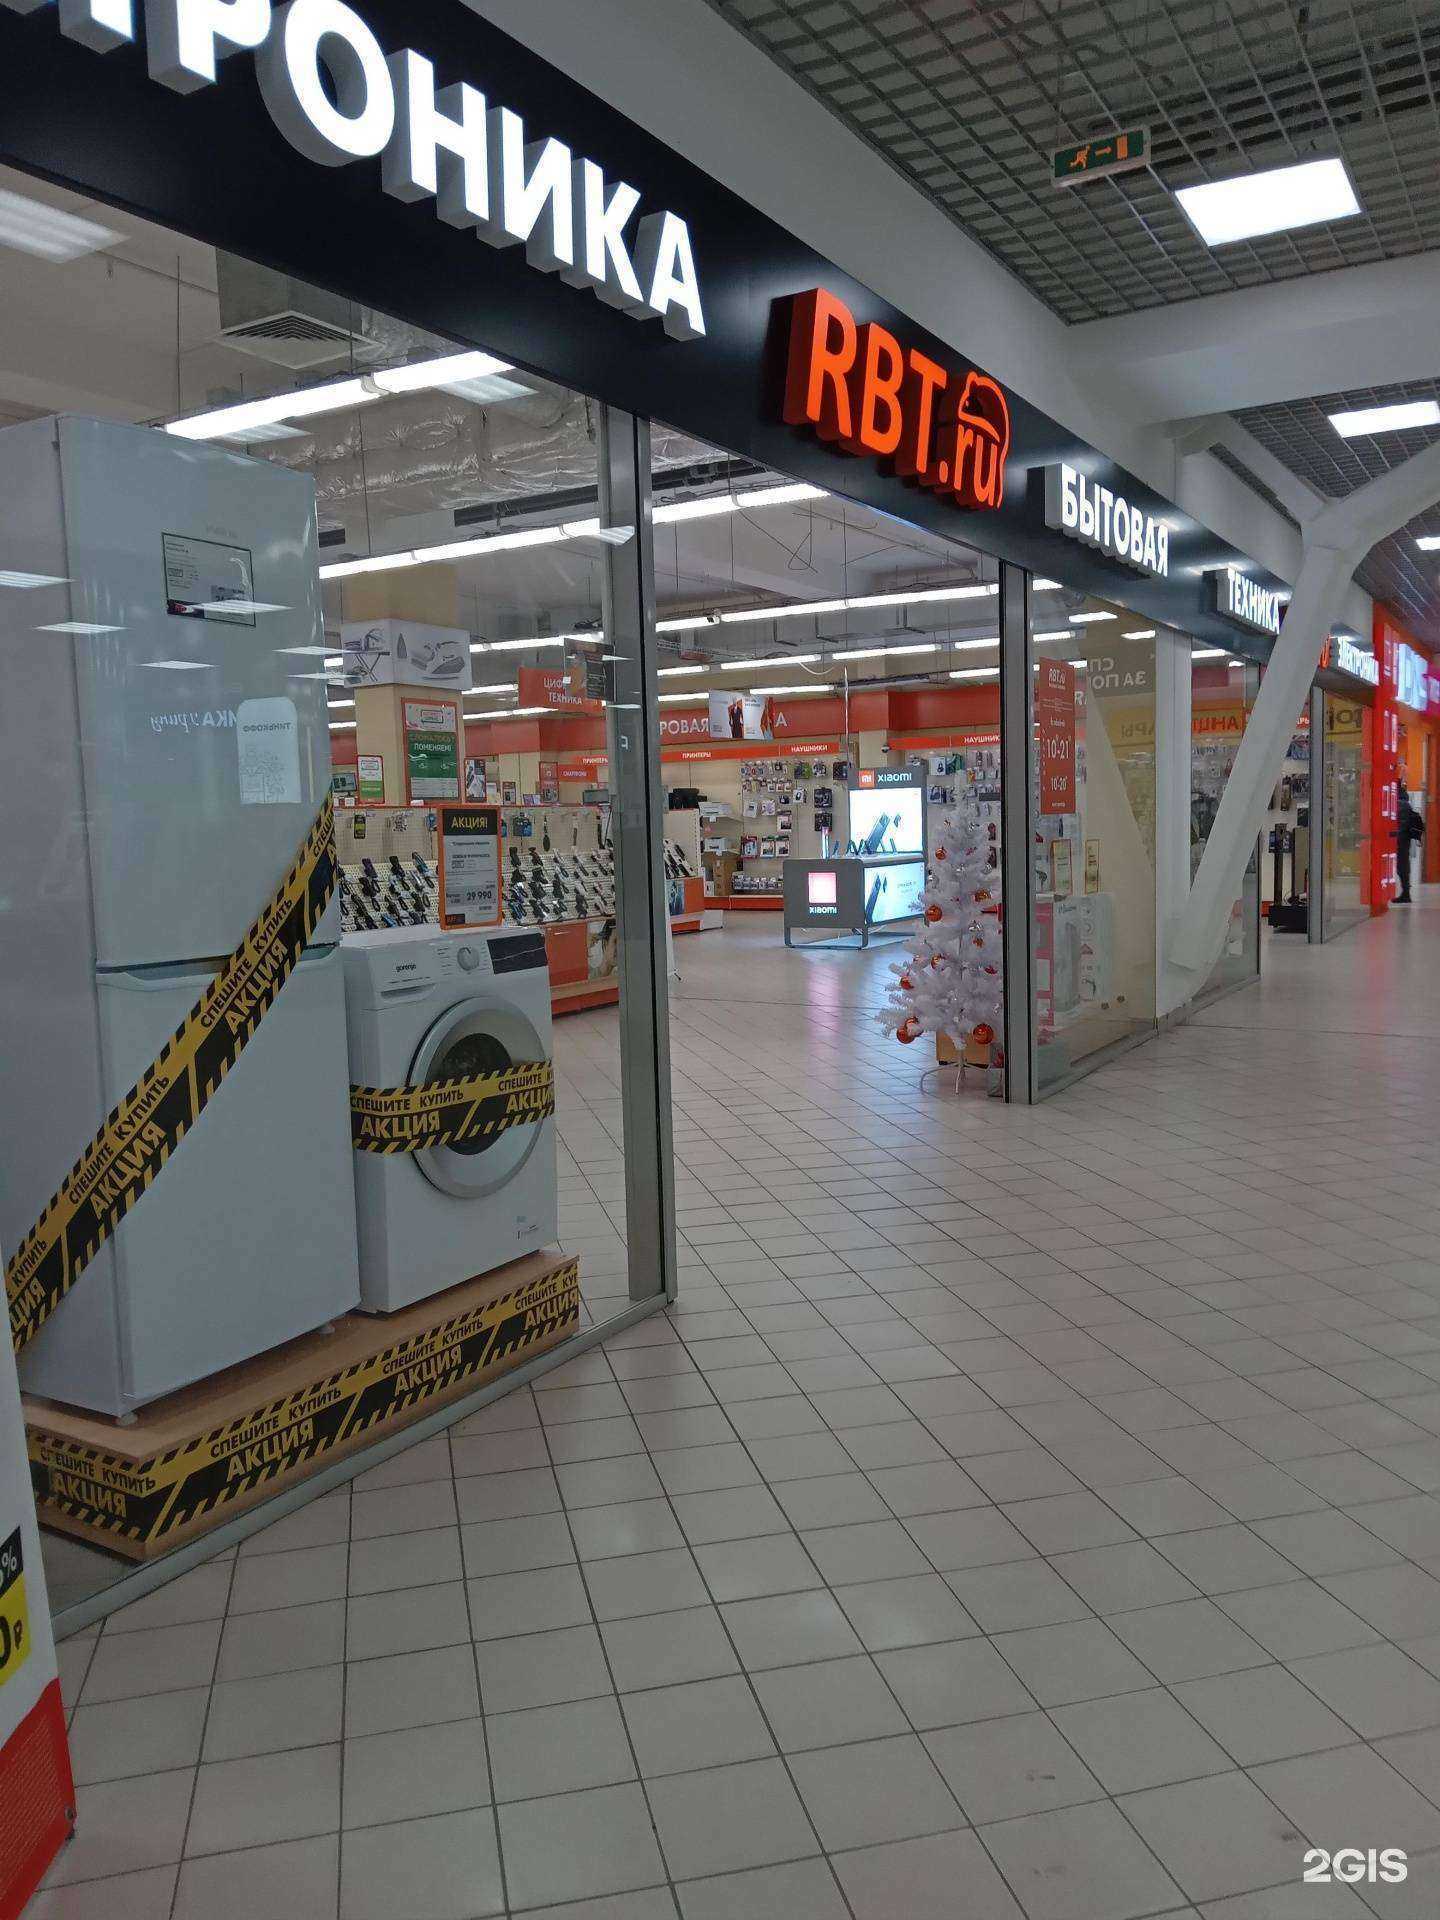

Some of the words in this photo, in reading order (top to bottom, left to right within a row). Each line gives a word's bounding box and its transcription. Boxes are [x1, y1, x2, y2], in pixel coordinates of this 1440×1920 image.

[806, 287, 999, 507] RBT.ru
[1060, 463, 1169, 578] БЫТОВАЯ
[1226, 567, 1280, 635] ТЕХНИКА
[548, 692, 583, 705] ТЕХНИКА
[791, 744, 828, 753] НАУШНИКИ
[451, 816, 488, 829] АКЦИЯ!
[200, 957, 253, 1029] СПЕШИТЕ
[253, 899, 293, 955] КУПИТЬ
[224, 937, 289, 1036] АКЦИЯ
[350, 1096, 411, 1113] СПЕШИТЕ
[419, 1089, 464, 1108] КУПИТЬ
[498, 1072, 542, 1092] СПЕШИТЕ
[68, 1142, 115, 1205] СПЕШИТЕ
[113, 1076, 170, 1141] КУПИТЬ
[359, 1110, 440, 1140] АКЦИЯ
[89, 1120, 168, 1221] АКЦИЯ
[11, 1239, 48, 1288] КУПИТЬ
[515, 1282, 558, 1311] СПЕШИТЕ
[525, 1288, 578, 1331] АКЦИЯ
[382, 1340, 436, 1375] СПЕШИТЕ
[442, 1319, 483, 1347] КУПИТЬ
[394, 1344, 462, 1397] АКЦИЯ
[210, 1415, 280, 1458] СПЕШИТЕ
[288, 1387, 342, 1423] КУПИТЬ
[226, 1417, 315, 1482] АКЦИЯ
[51, 1471, 127, 1519] АКЦИЯ
[102, 1467, 156, 1494] КУПИТЬ
